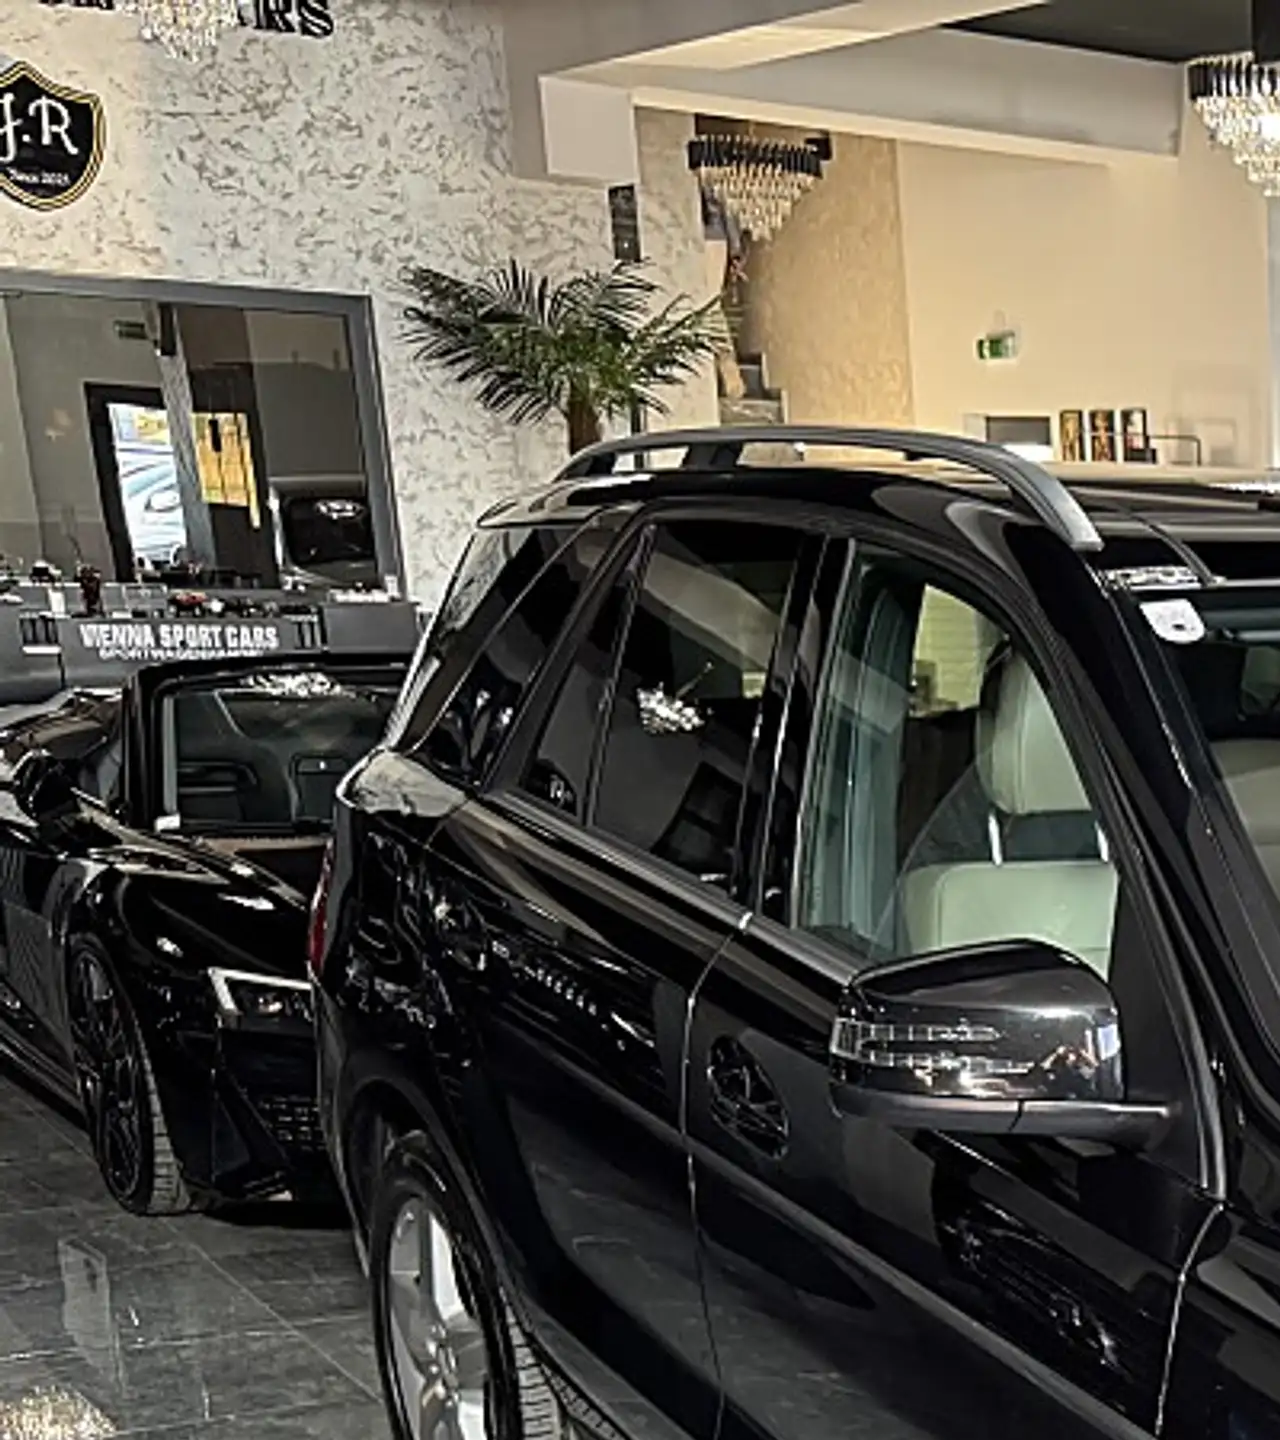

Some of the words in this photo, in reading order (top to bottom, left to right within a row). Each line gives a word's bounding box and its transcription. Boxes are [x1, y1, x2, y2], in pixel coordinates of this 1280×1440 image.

[79, 623, 156, 648] VIENNA
[159, 623, 222, 649] SPORT
[224, 624, 280, 650] CARS
